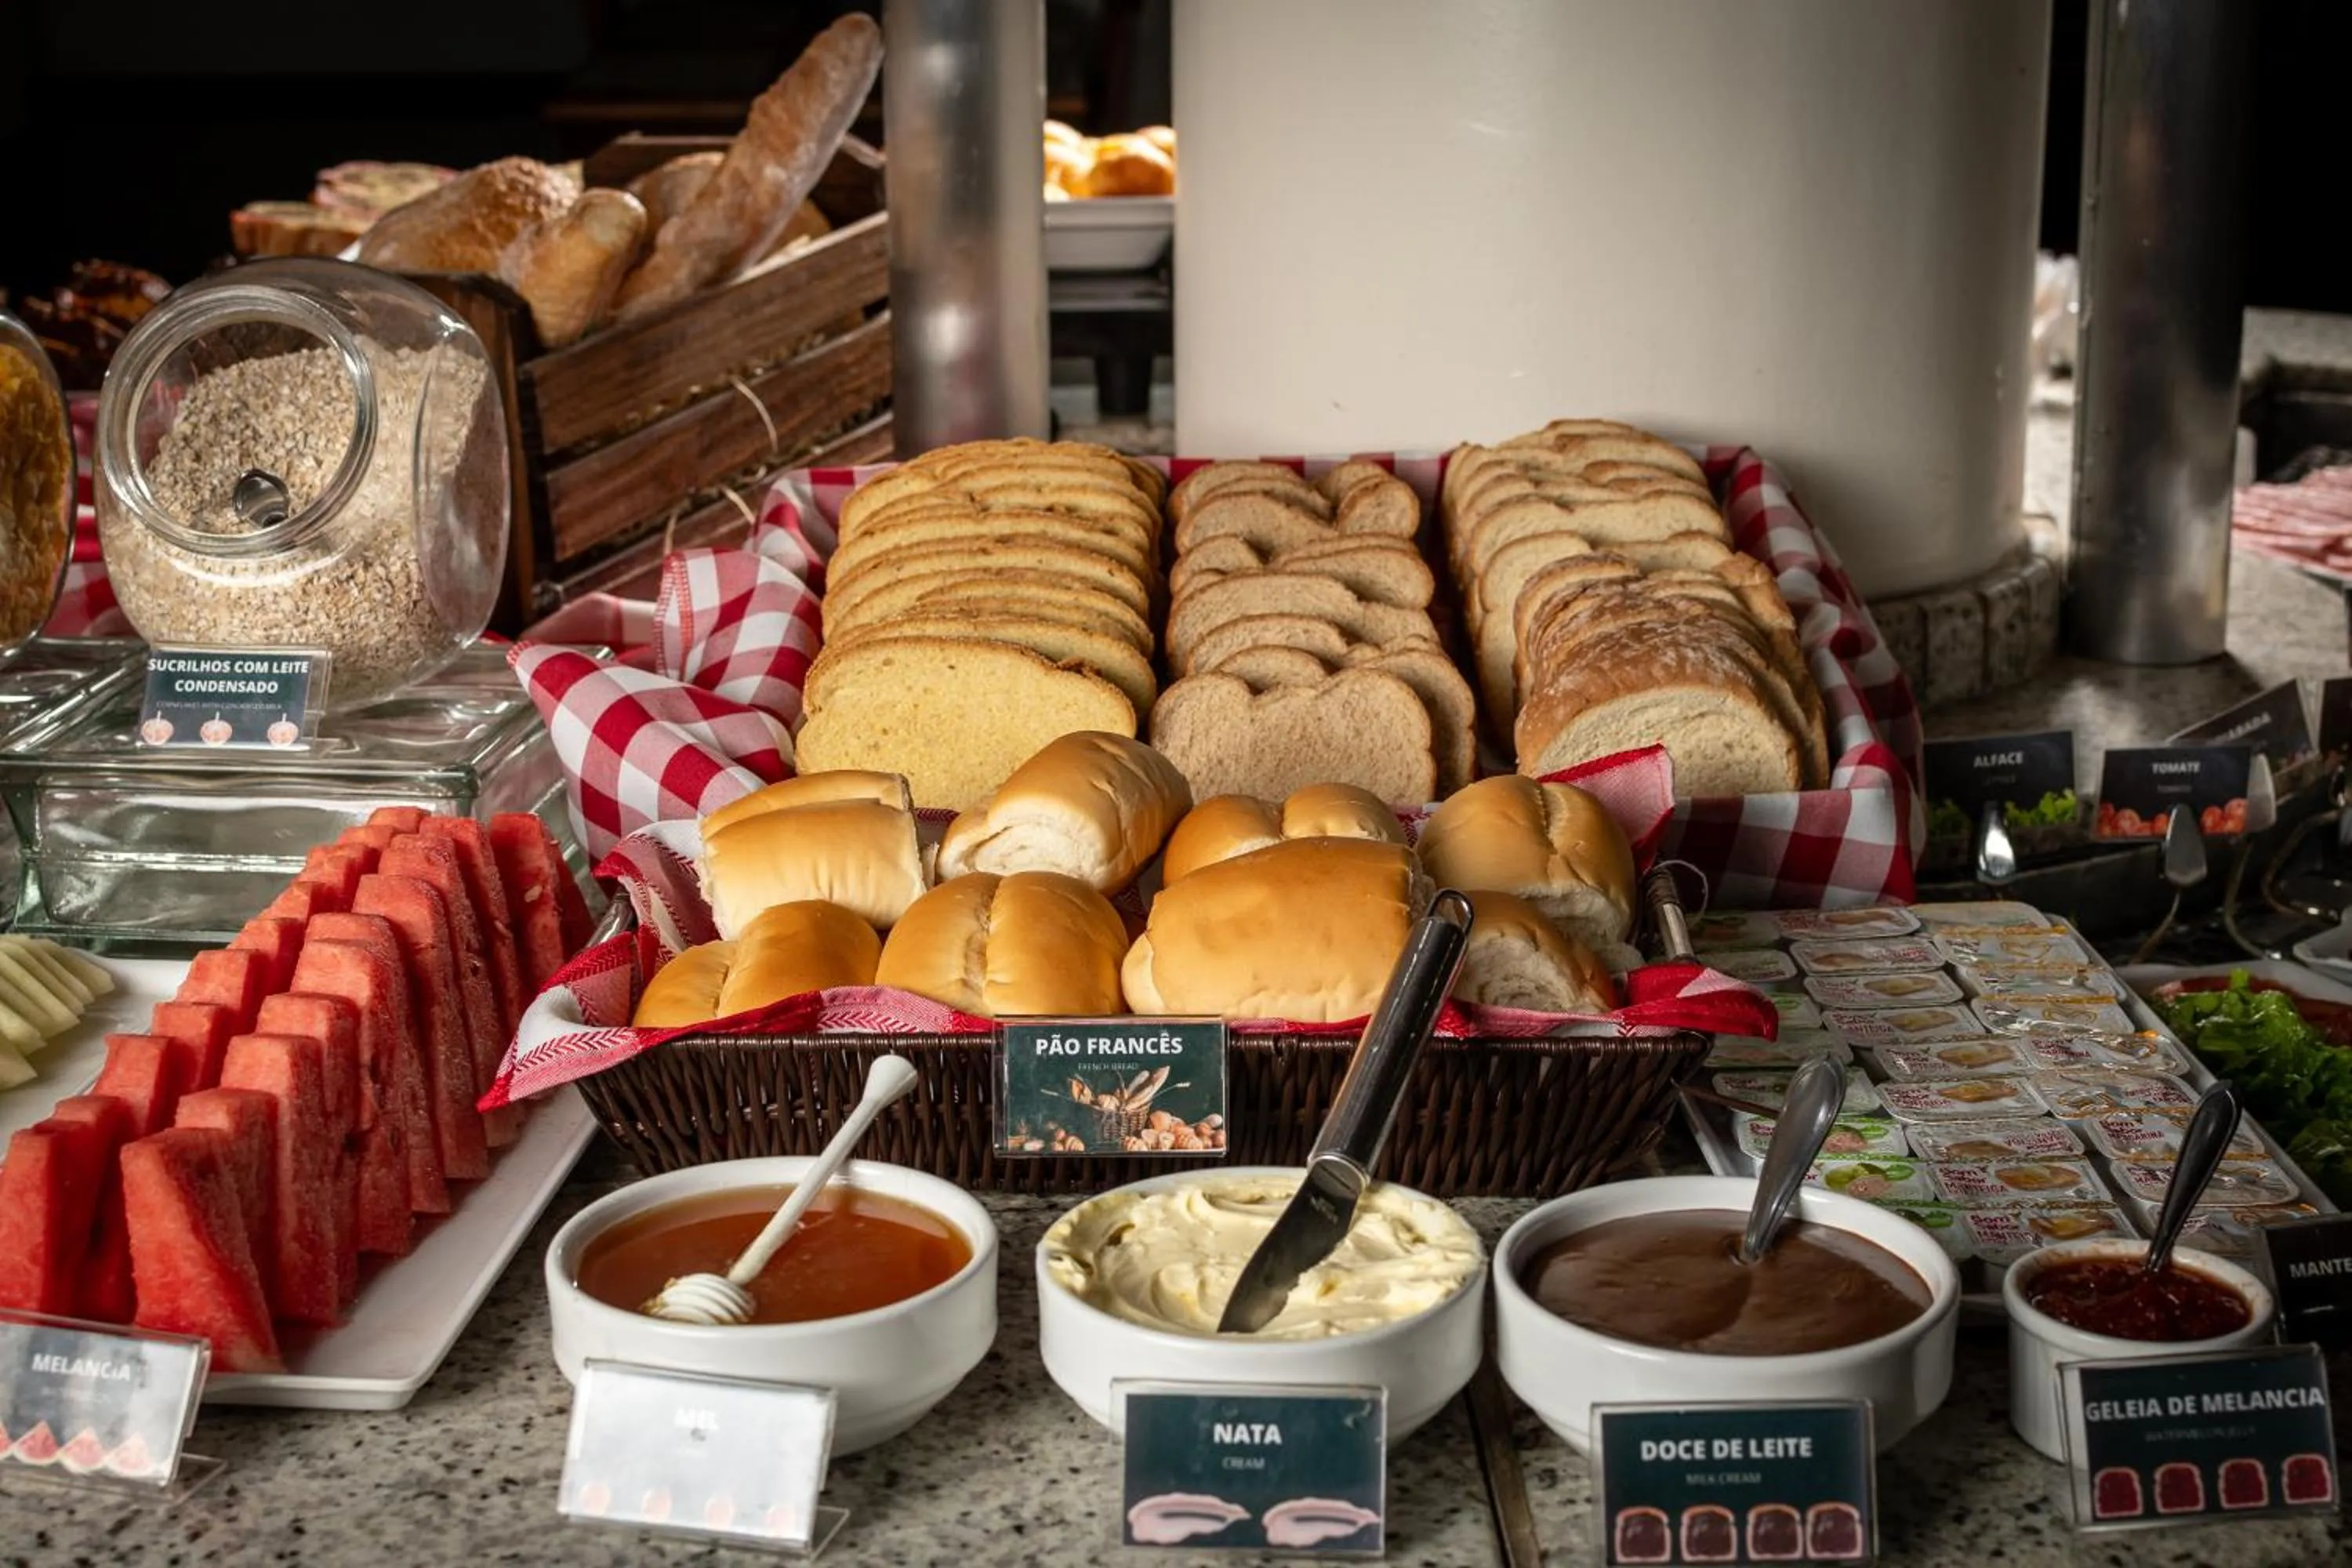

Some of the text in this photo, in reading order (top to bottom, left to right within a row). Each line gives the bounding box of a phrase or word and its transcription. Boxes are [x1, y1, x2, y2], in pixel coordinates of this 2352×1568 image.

[147, 659, 310, 674] SUCRILHOS COM LEITE
[174, 679, 279, 694] CONDENSADO
[1973, 750, 2025, 768] ALFACE
[2151, 760, 2201, 775] TOMATE
[1035, 1032, 1184, 1054] PÃO FRANCÊS
[31, 1352, 131, 1381] MELANCIA
[2085, 1387, 2326, 1422] GELEIA DE MELANCIA
[1213, 1423, 1283, 1445] NATA
[1641, 1437, 1813, 1461] DOCE DE LEITE
[1221, 1457, 1265, 1470] CREAM
[1685, 1472, 1762, 1485] MILK CREAM
